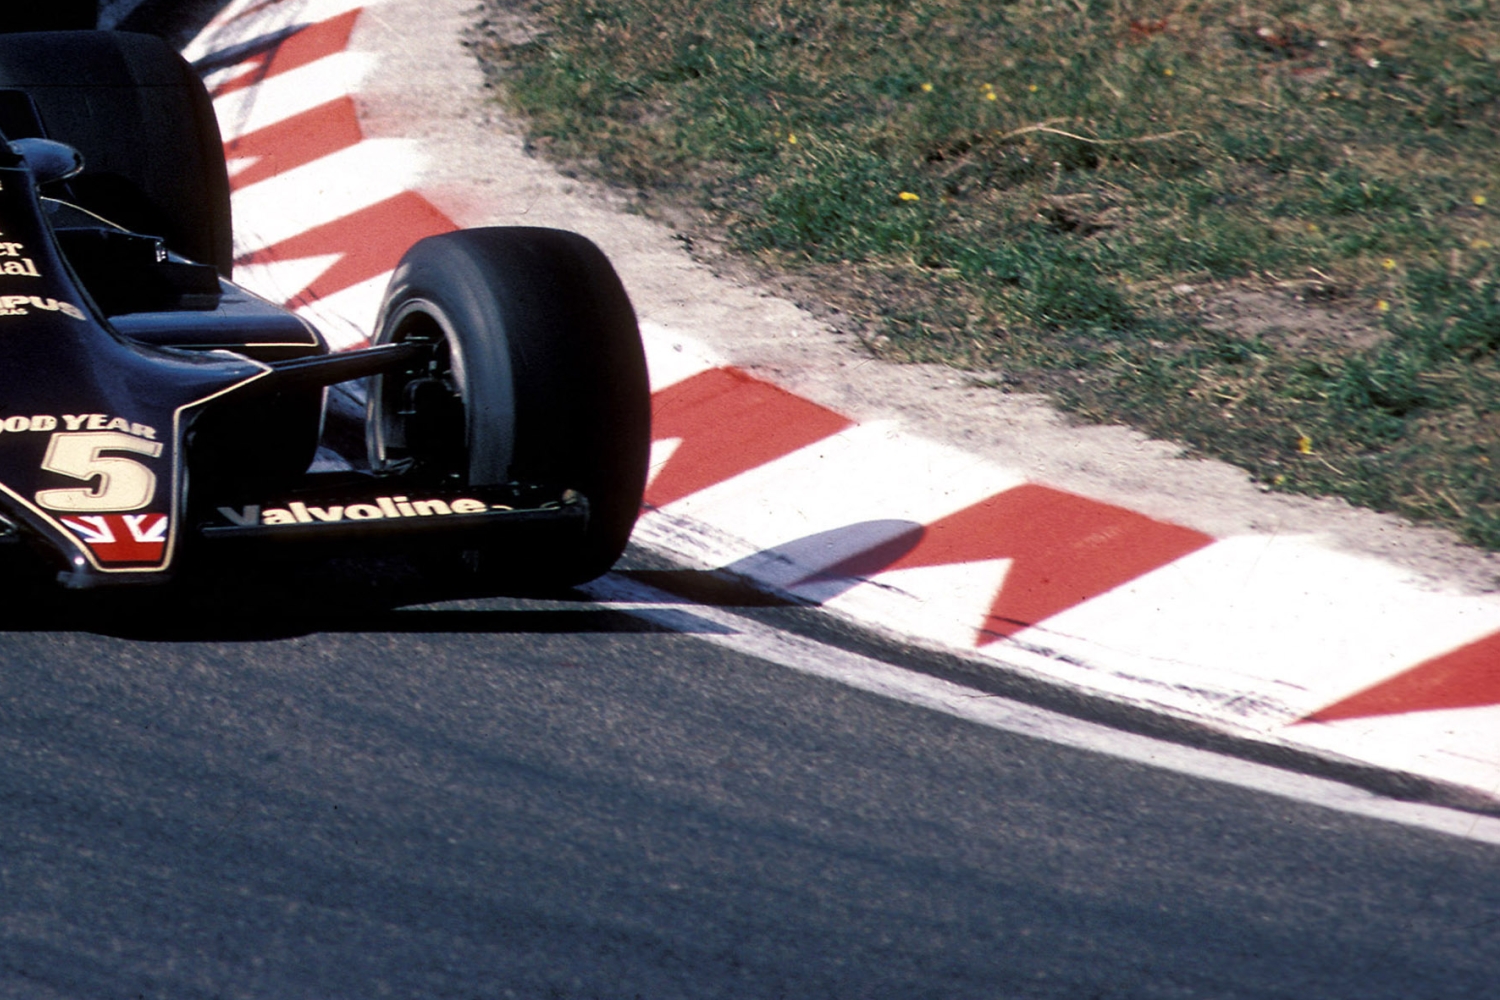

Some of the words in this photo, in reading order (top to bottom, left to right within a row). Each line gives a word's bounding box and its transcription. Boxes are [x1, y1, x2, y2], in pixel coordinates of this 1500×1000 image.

[61, 413, 157, 440] YEAR
[34, 431, 164, 512] 5
[216, 495, 490, 526] Valvoline
